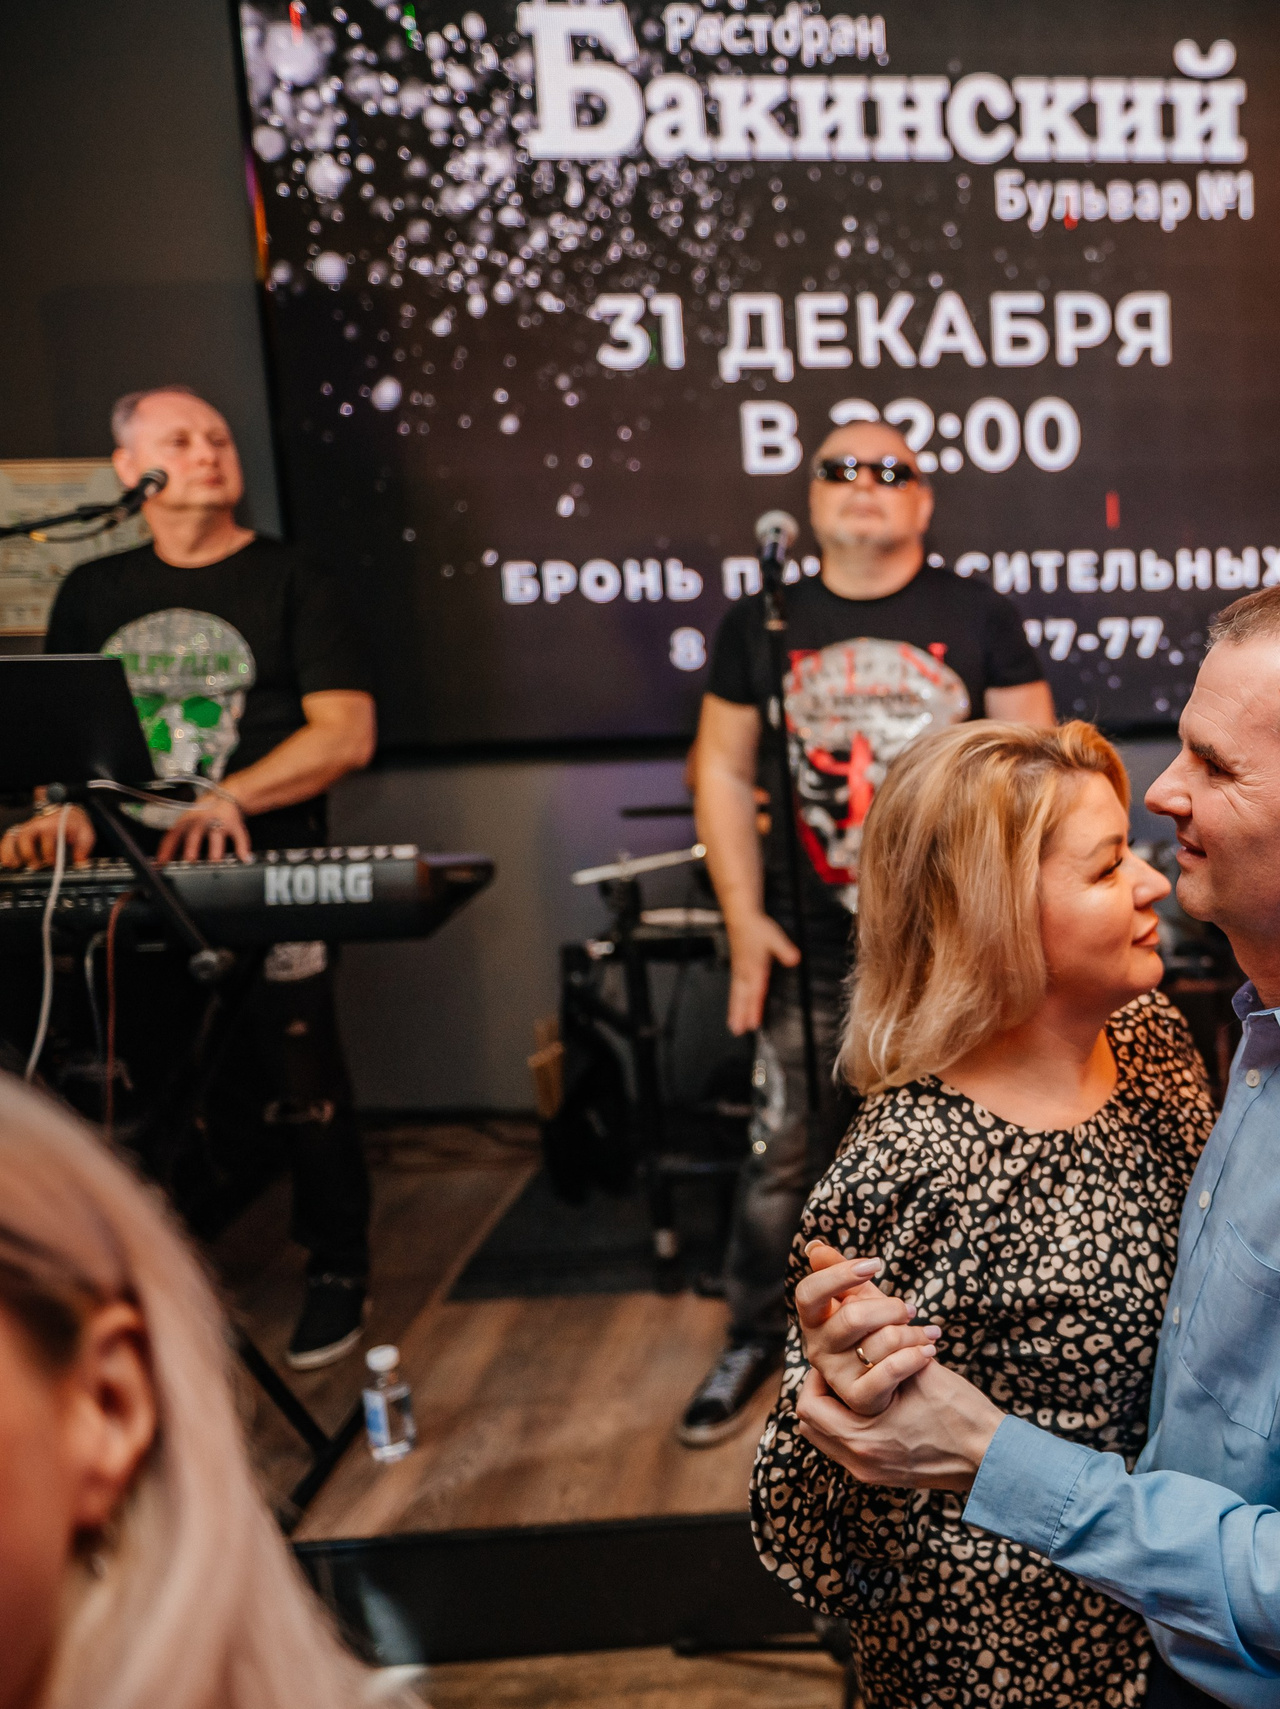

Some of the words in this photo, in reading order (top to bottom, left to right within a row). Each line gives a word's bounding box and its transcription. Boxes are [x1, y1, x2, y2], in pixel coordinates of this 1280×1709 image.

[663, 2, 887, 68] Ресторан
[516, 1, 1248, 162] Бакинский
[994, 168, 1192, 233] Бульвар
[597, 292, 685, 370] 31
[719, 290, 1172, 383] ДЕКАБРЯ
[502, 558, 703, 605] БРОНЬ
[264, 864, 373, 906] KORG
